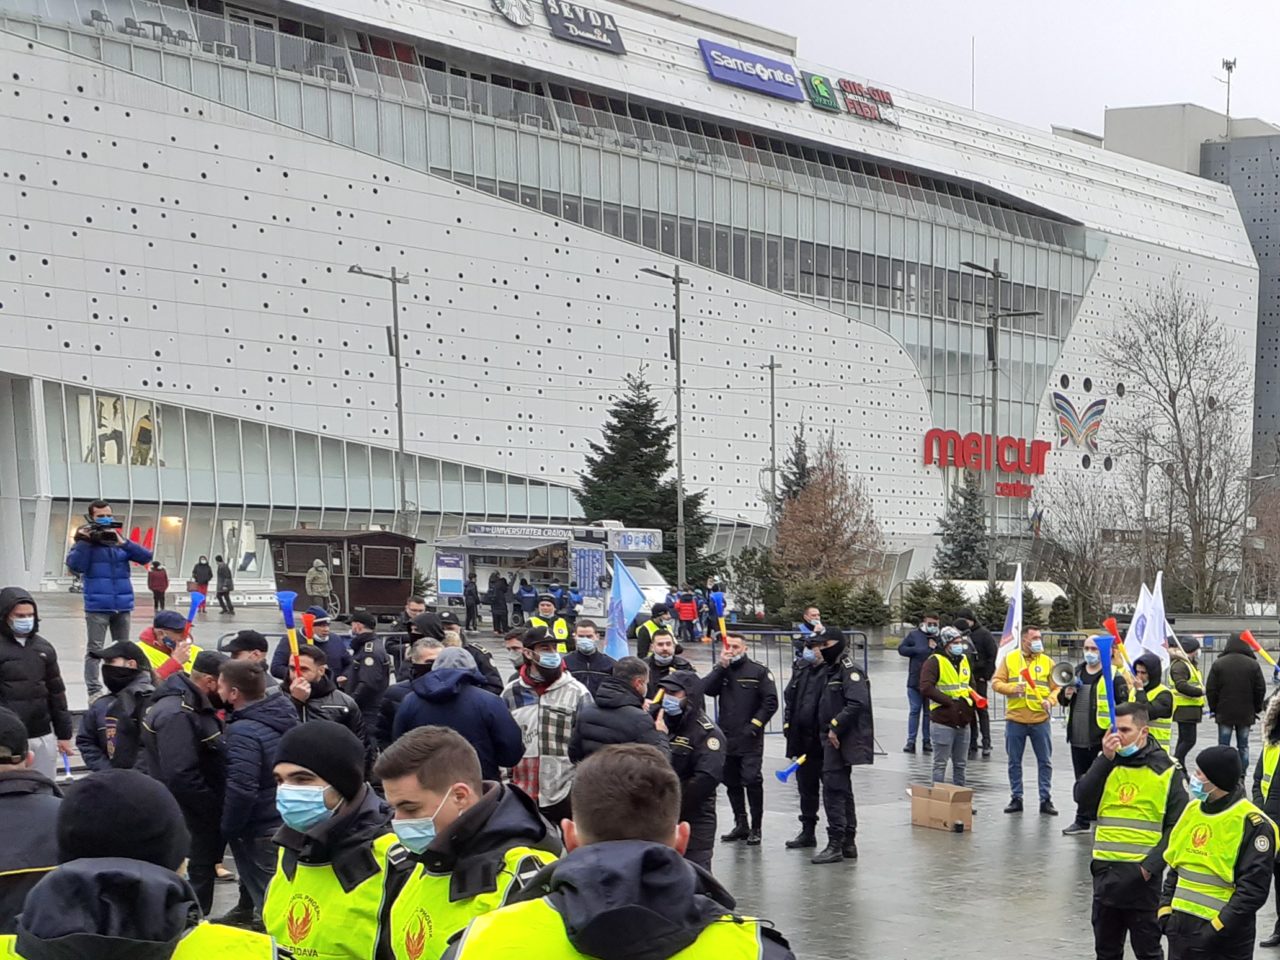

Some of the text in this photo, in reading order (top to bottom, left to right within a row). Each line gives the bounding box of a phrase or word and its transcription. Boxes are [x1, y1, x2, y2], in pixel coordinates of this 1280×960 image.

[546, 0, 616, 31] SEVDA
[710, 50, 796, 86] Samsonite
[844, 97, 880, 120] FLEX
[491, 526, 541, 537] UNIVERSITATEA
[543, 528, 572, 538] CRAIOVA
[622, 534, 633, 546] 19
